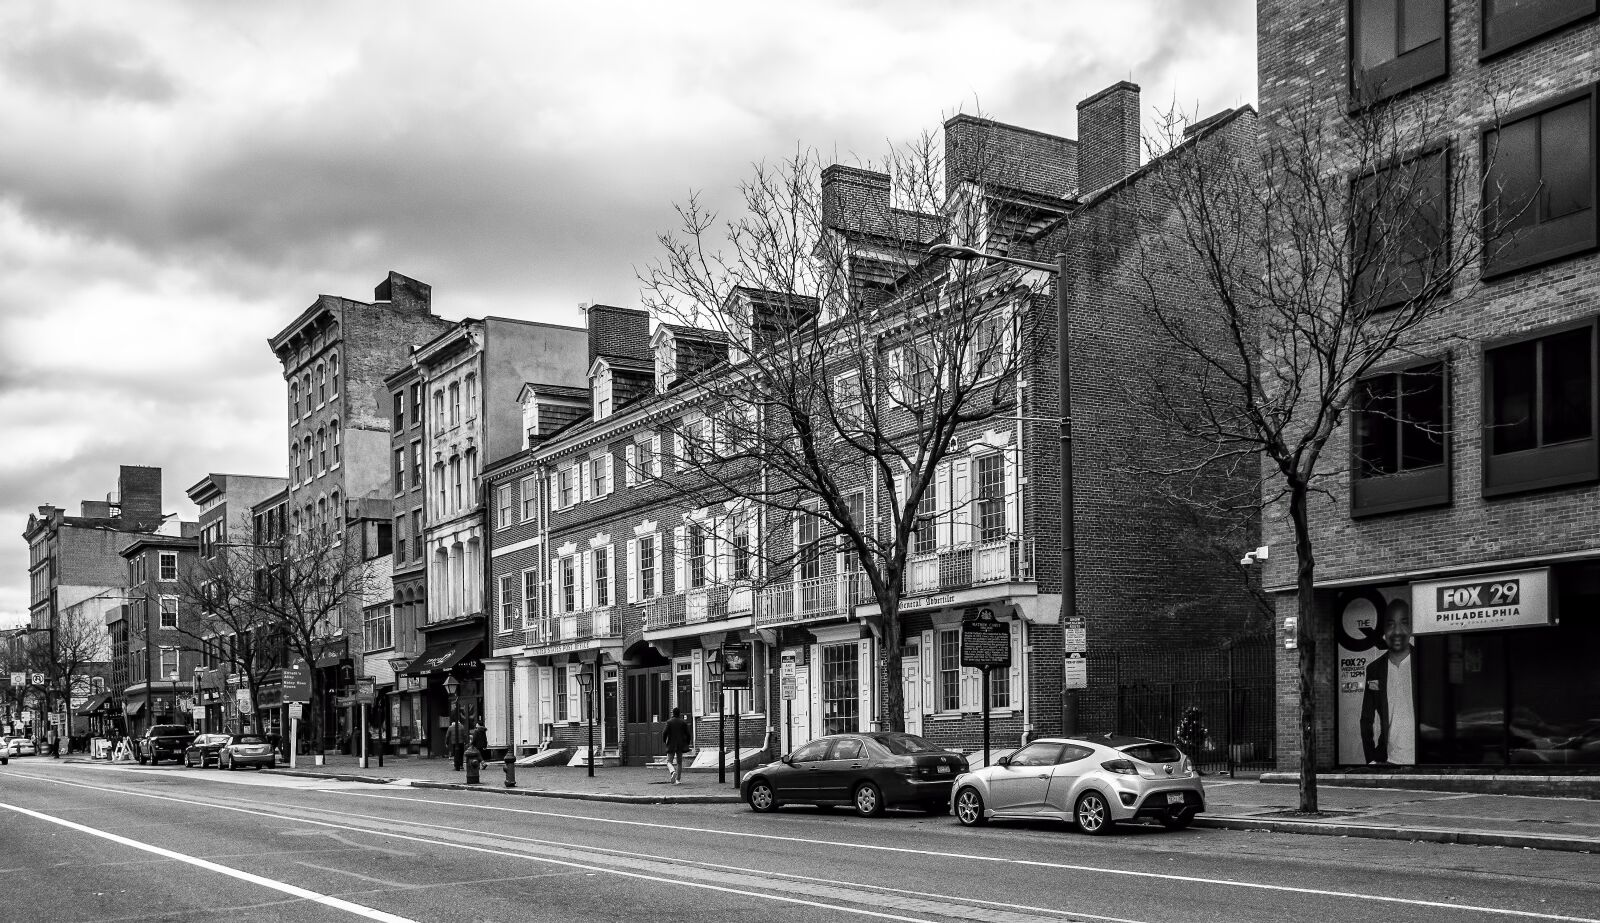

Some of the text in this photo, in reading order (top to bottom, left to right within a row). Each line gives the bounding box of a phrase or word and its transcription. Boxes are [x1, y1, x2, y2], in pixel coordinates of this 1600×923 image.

[1443, 582, 1518, 608] FOX 29
[1436, 608, 1520, 622] PHILADELPHIA
[1341, 657, 1366, 667] FOX 29
